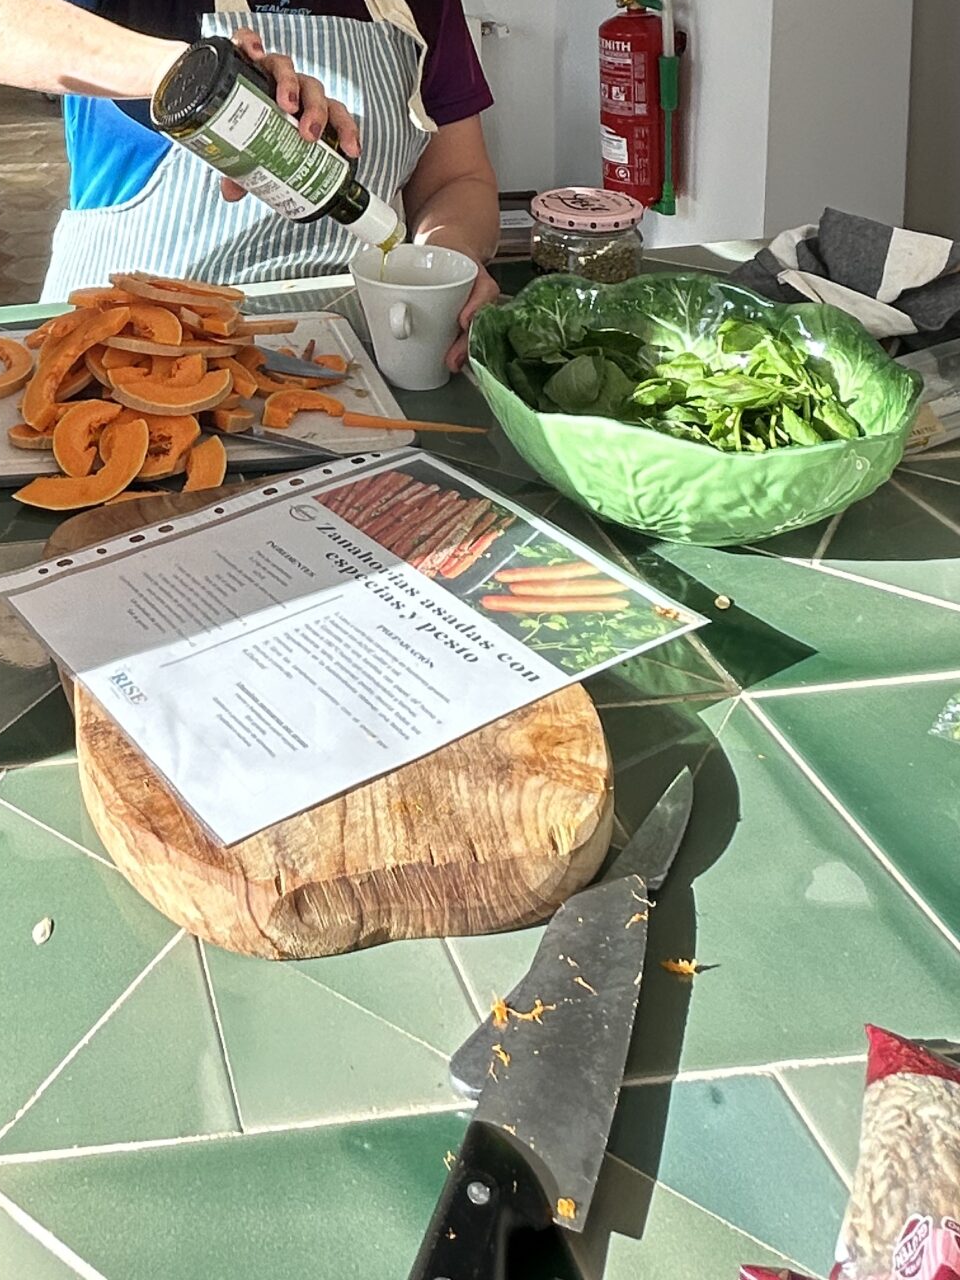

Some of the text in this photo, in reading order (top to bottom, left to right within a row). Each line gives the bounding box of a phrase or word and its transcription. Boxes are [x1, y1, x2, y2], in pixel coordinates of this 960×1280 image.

[315, 522, 541, 683] Zanahorias asadas con
[325, 550, 406, 611] especias
[416, 622, 479, 665] pesto
[111, 671, 148, 705] RISE
